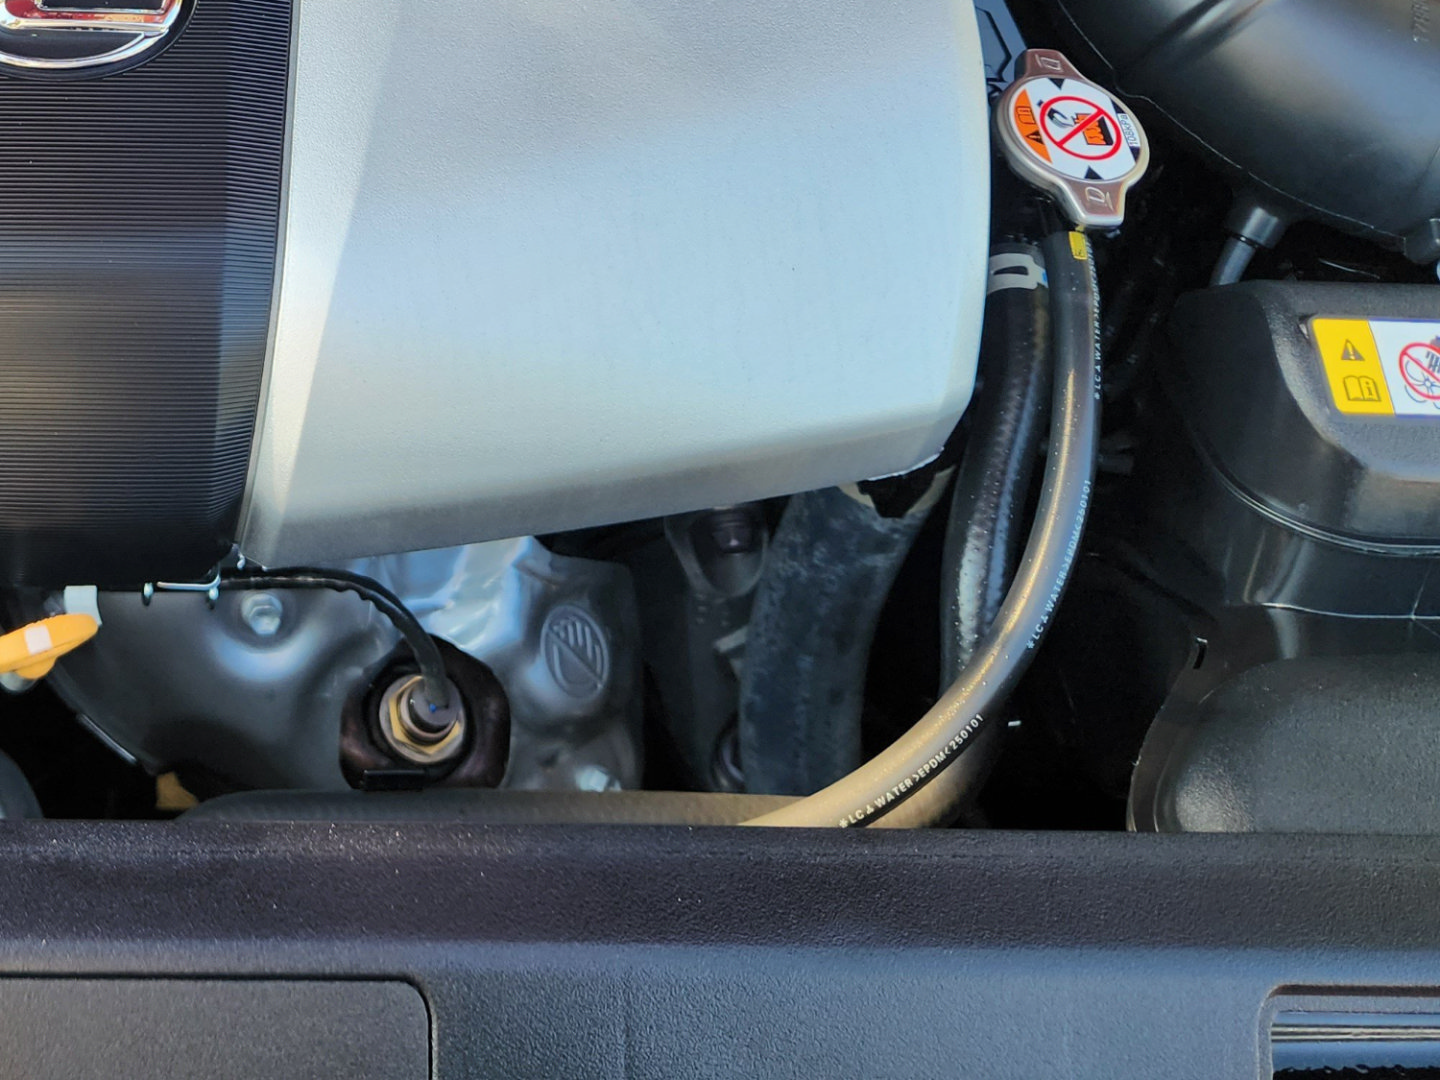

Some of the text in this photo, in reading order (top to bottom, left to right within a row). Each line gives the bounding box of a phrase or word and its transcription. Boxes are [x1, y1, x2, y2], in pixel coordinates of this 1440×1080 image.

[1045, 570, 1067, 613] WATER
[874, 778, 914, 809] WATER
[912, 749, 951, 783] >EPDM<
[949, 713, 984, 750] 250101
